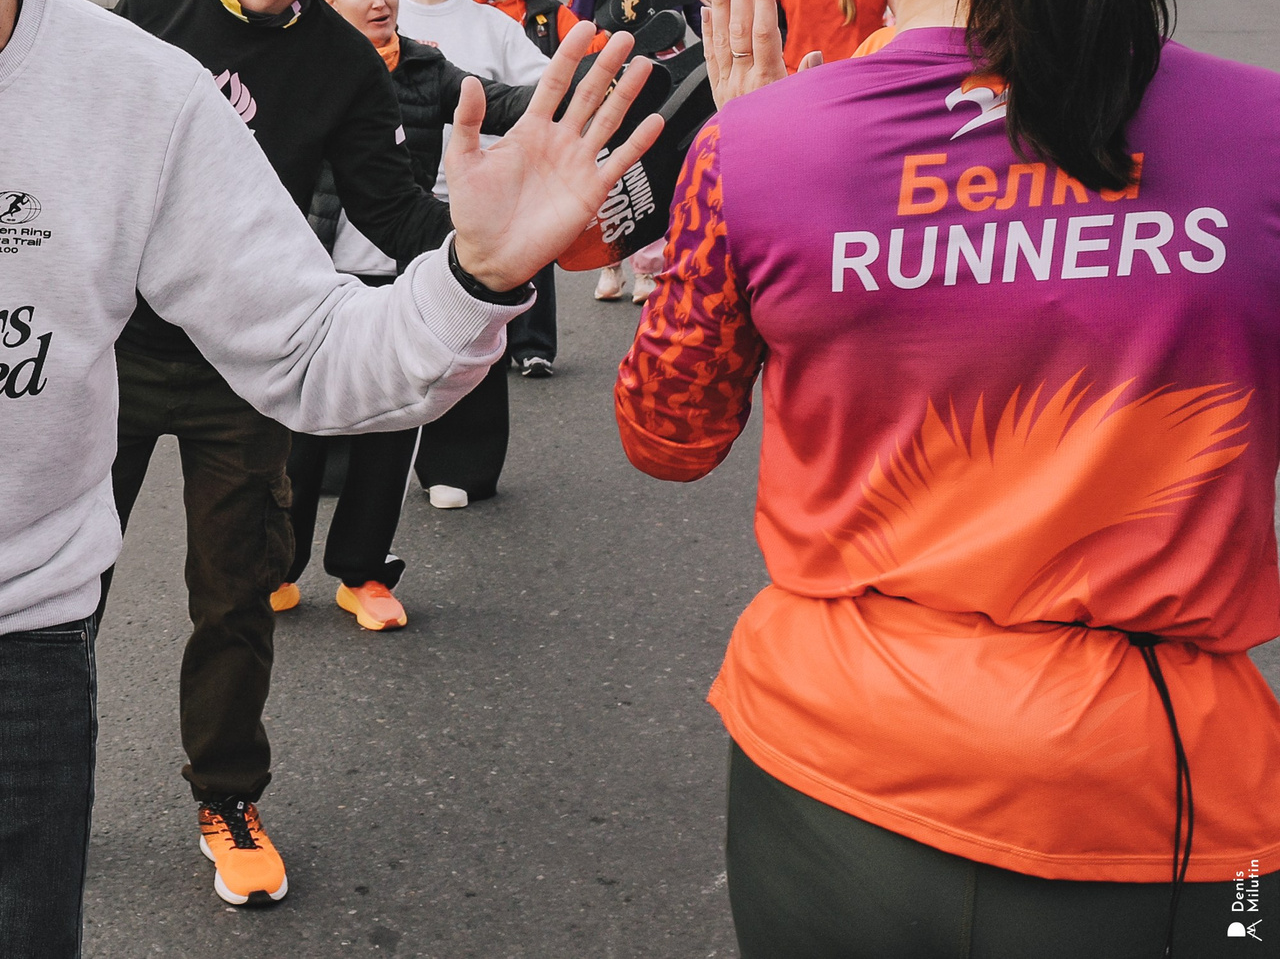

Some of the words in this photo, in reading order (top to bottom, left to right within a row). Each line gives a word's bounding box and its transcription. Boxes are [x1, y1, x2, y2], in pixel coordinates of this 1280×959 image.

[20, 228, 52, 239] Ring
[13, 237, 42, 246] Trail
[831, 207, 1229, 293] RUNNERS
